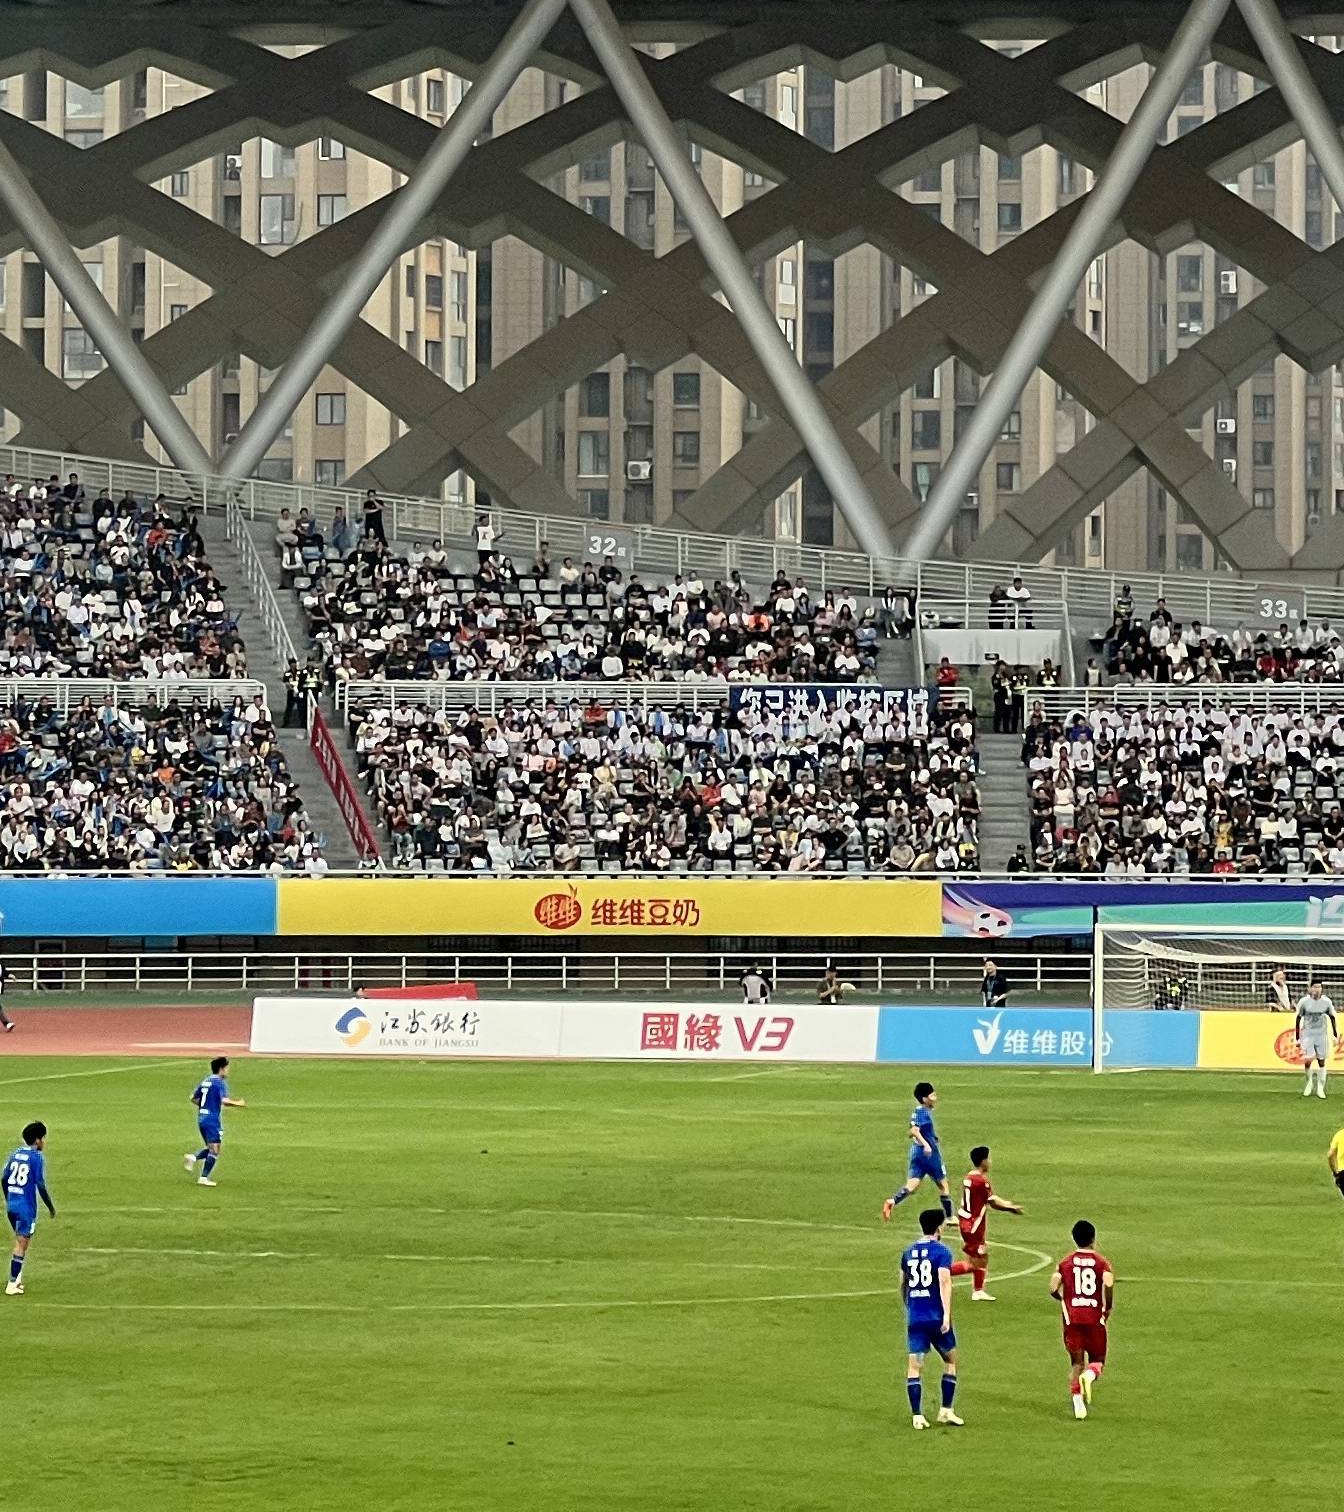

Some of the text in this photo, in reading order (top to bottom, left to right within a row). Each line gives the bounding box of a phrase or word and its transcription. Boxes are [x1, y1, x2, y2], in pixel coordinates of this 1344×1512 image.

[591, 898, 700, 927] 维维豆奶
[380, 1008, 481, 1036] 江苏银行
[733, 1016, 795, 1052] V3
[7, 1161, 30, 1186] 28
[906, 1258, 932, 1288] 38
[1073, 1266, 1097, 1296] 18
